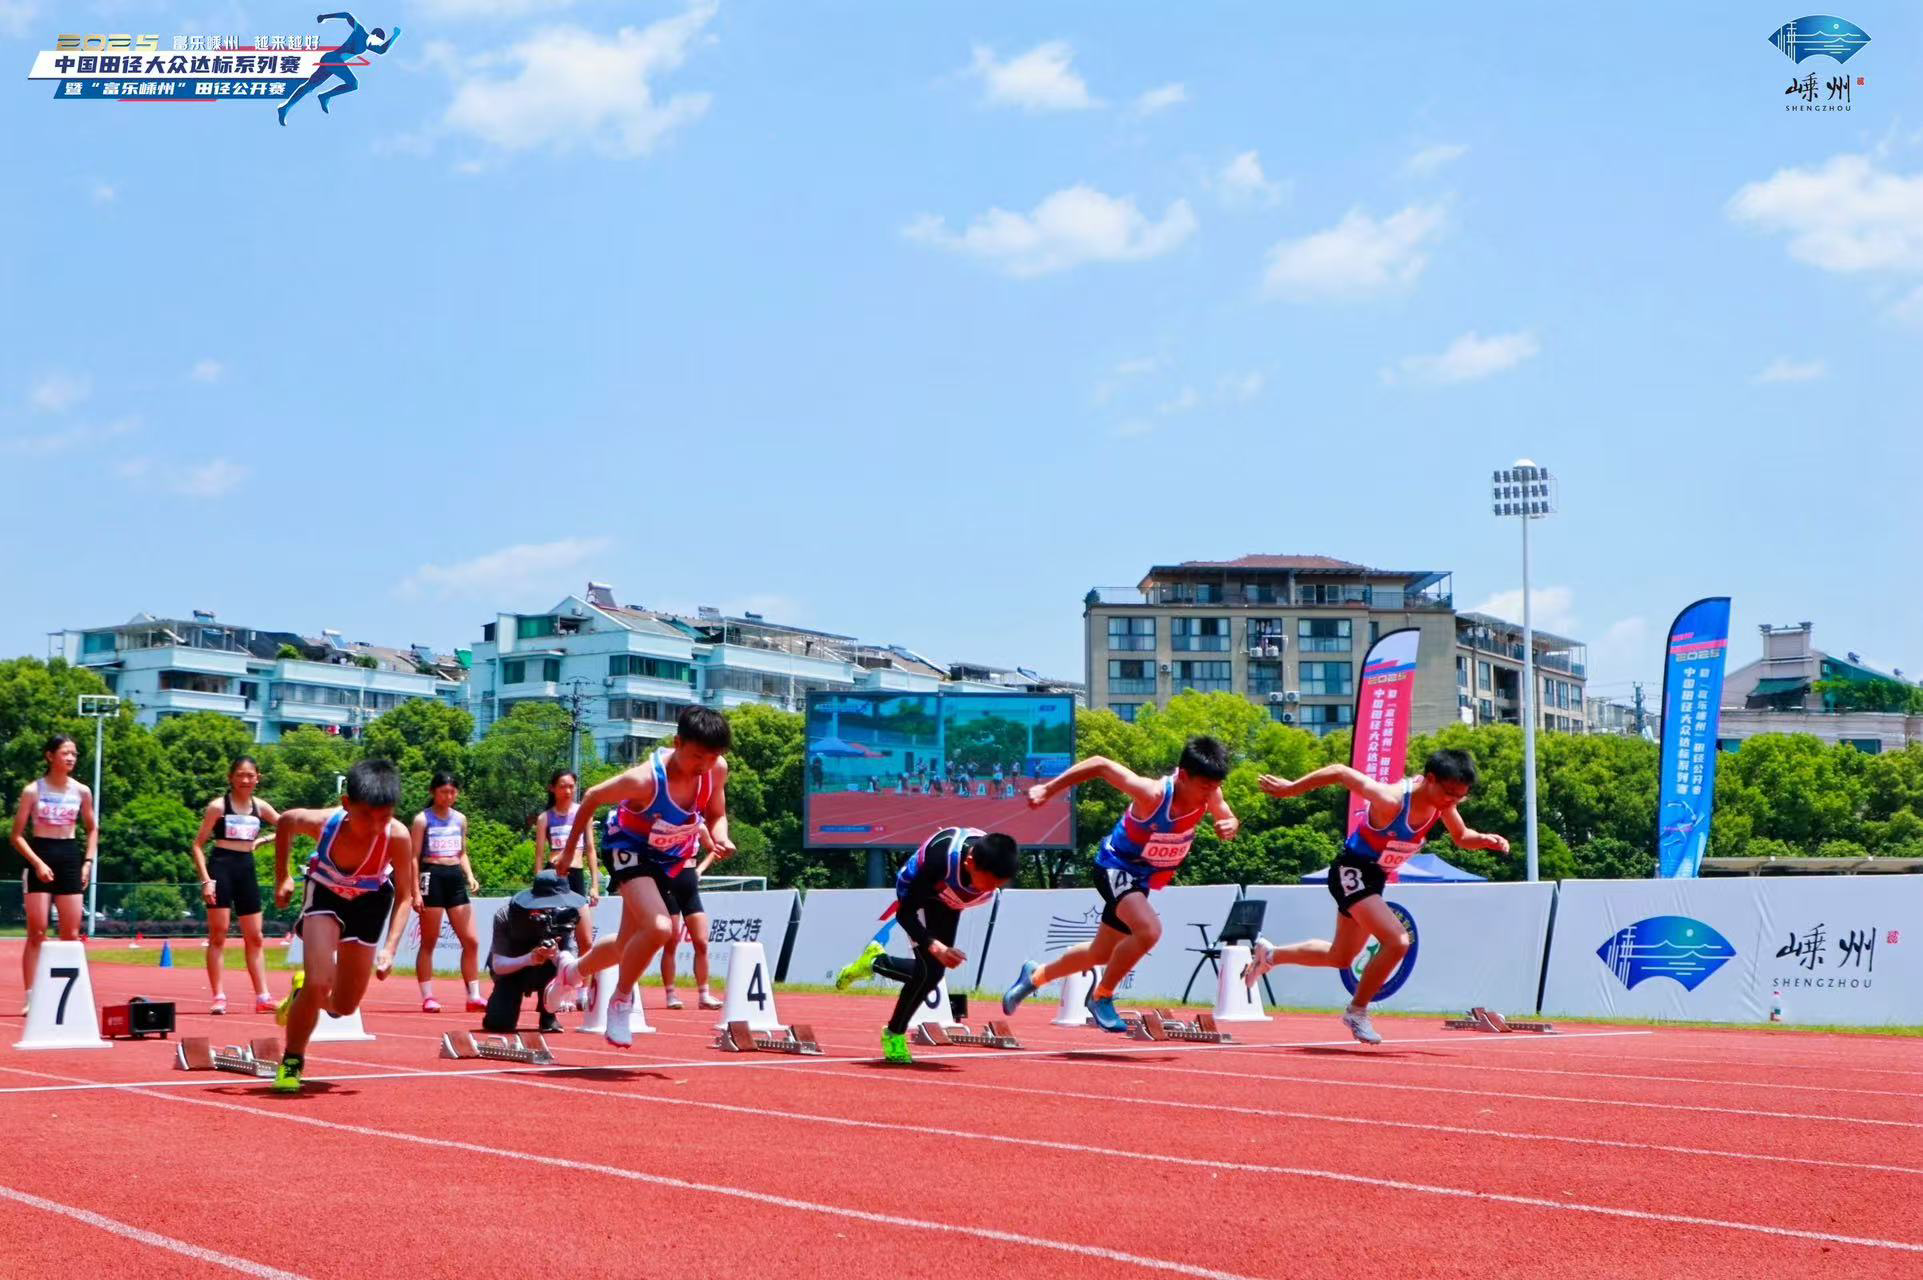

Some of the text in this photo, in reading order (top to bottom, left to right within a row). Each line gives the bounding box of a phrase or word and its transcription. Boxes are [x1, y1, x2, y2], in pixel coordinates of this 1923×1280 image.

[1344, 869, 1360, 891] 3
[1776, 923, 1876, 972] 嵊州
[50, 967, 79, 1025] 7
[747, 963, 767, 1011] 4
[1773, 978, 1872, 988] SHENGZHOU
